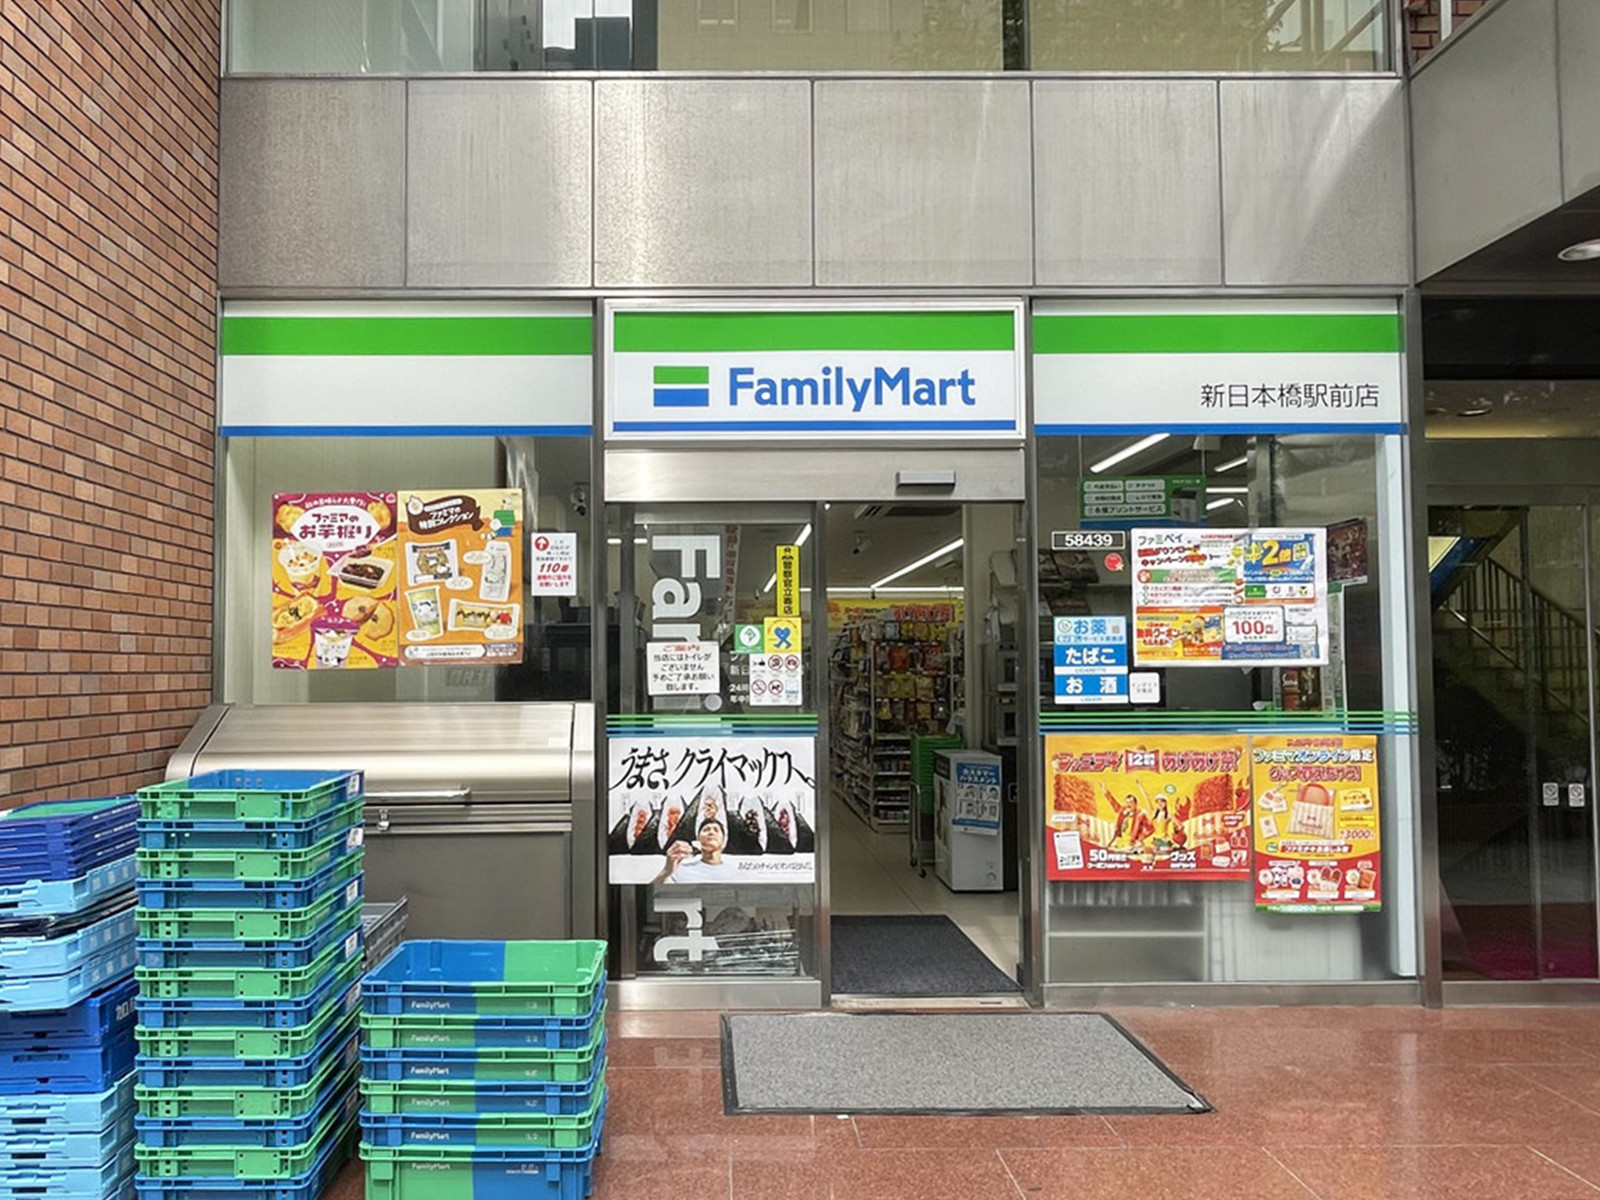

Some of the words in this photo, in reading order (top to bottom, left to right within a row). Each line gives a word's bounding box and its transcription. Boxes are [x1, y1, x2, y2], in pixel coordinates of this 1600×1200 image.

[729, 366, 976, 412] FamilyMart
[1200, 383, 1379, 408] 新日本橋駅前店
[312, 513, 360, 523] ファミマの
[299, 524, 372, 539] お芋掘り
[1064, 534, 1113, 547] 58439
[1138, 533, 1183, 546] ファミペイ
[1073, 619, 1107, 634] お薬
[653, 653, 712, 662] 当店にはトイレが
[1065, 647, 1116, 665] たばこ
[661, 663, 705, 671] ございません
[1252, 749, 1374, 764] ファミマオンライン限定
[609, 747, 816, 790] うまさ、クライマックス。
[962, 768, 995, 776] カスタマー
[411, 1001, 450, 1010] FamilyMart
[411, 1034, 450, 1043] FamilyMart
[410, 1066, 450, 1075] FamilyMart
[411, 1098, 450, 1107] FamilyMart
[410, 1132, 450, 1140] FamilyMart
[411, 1163, 451, 1171] FamilyMart
